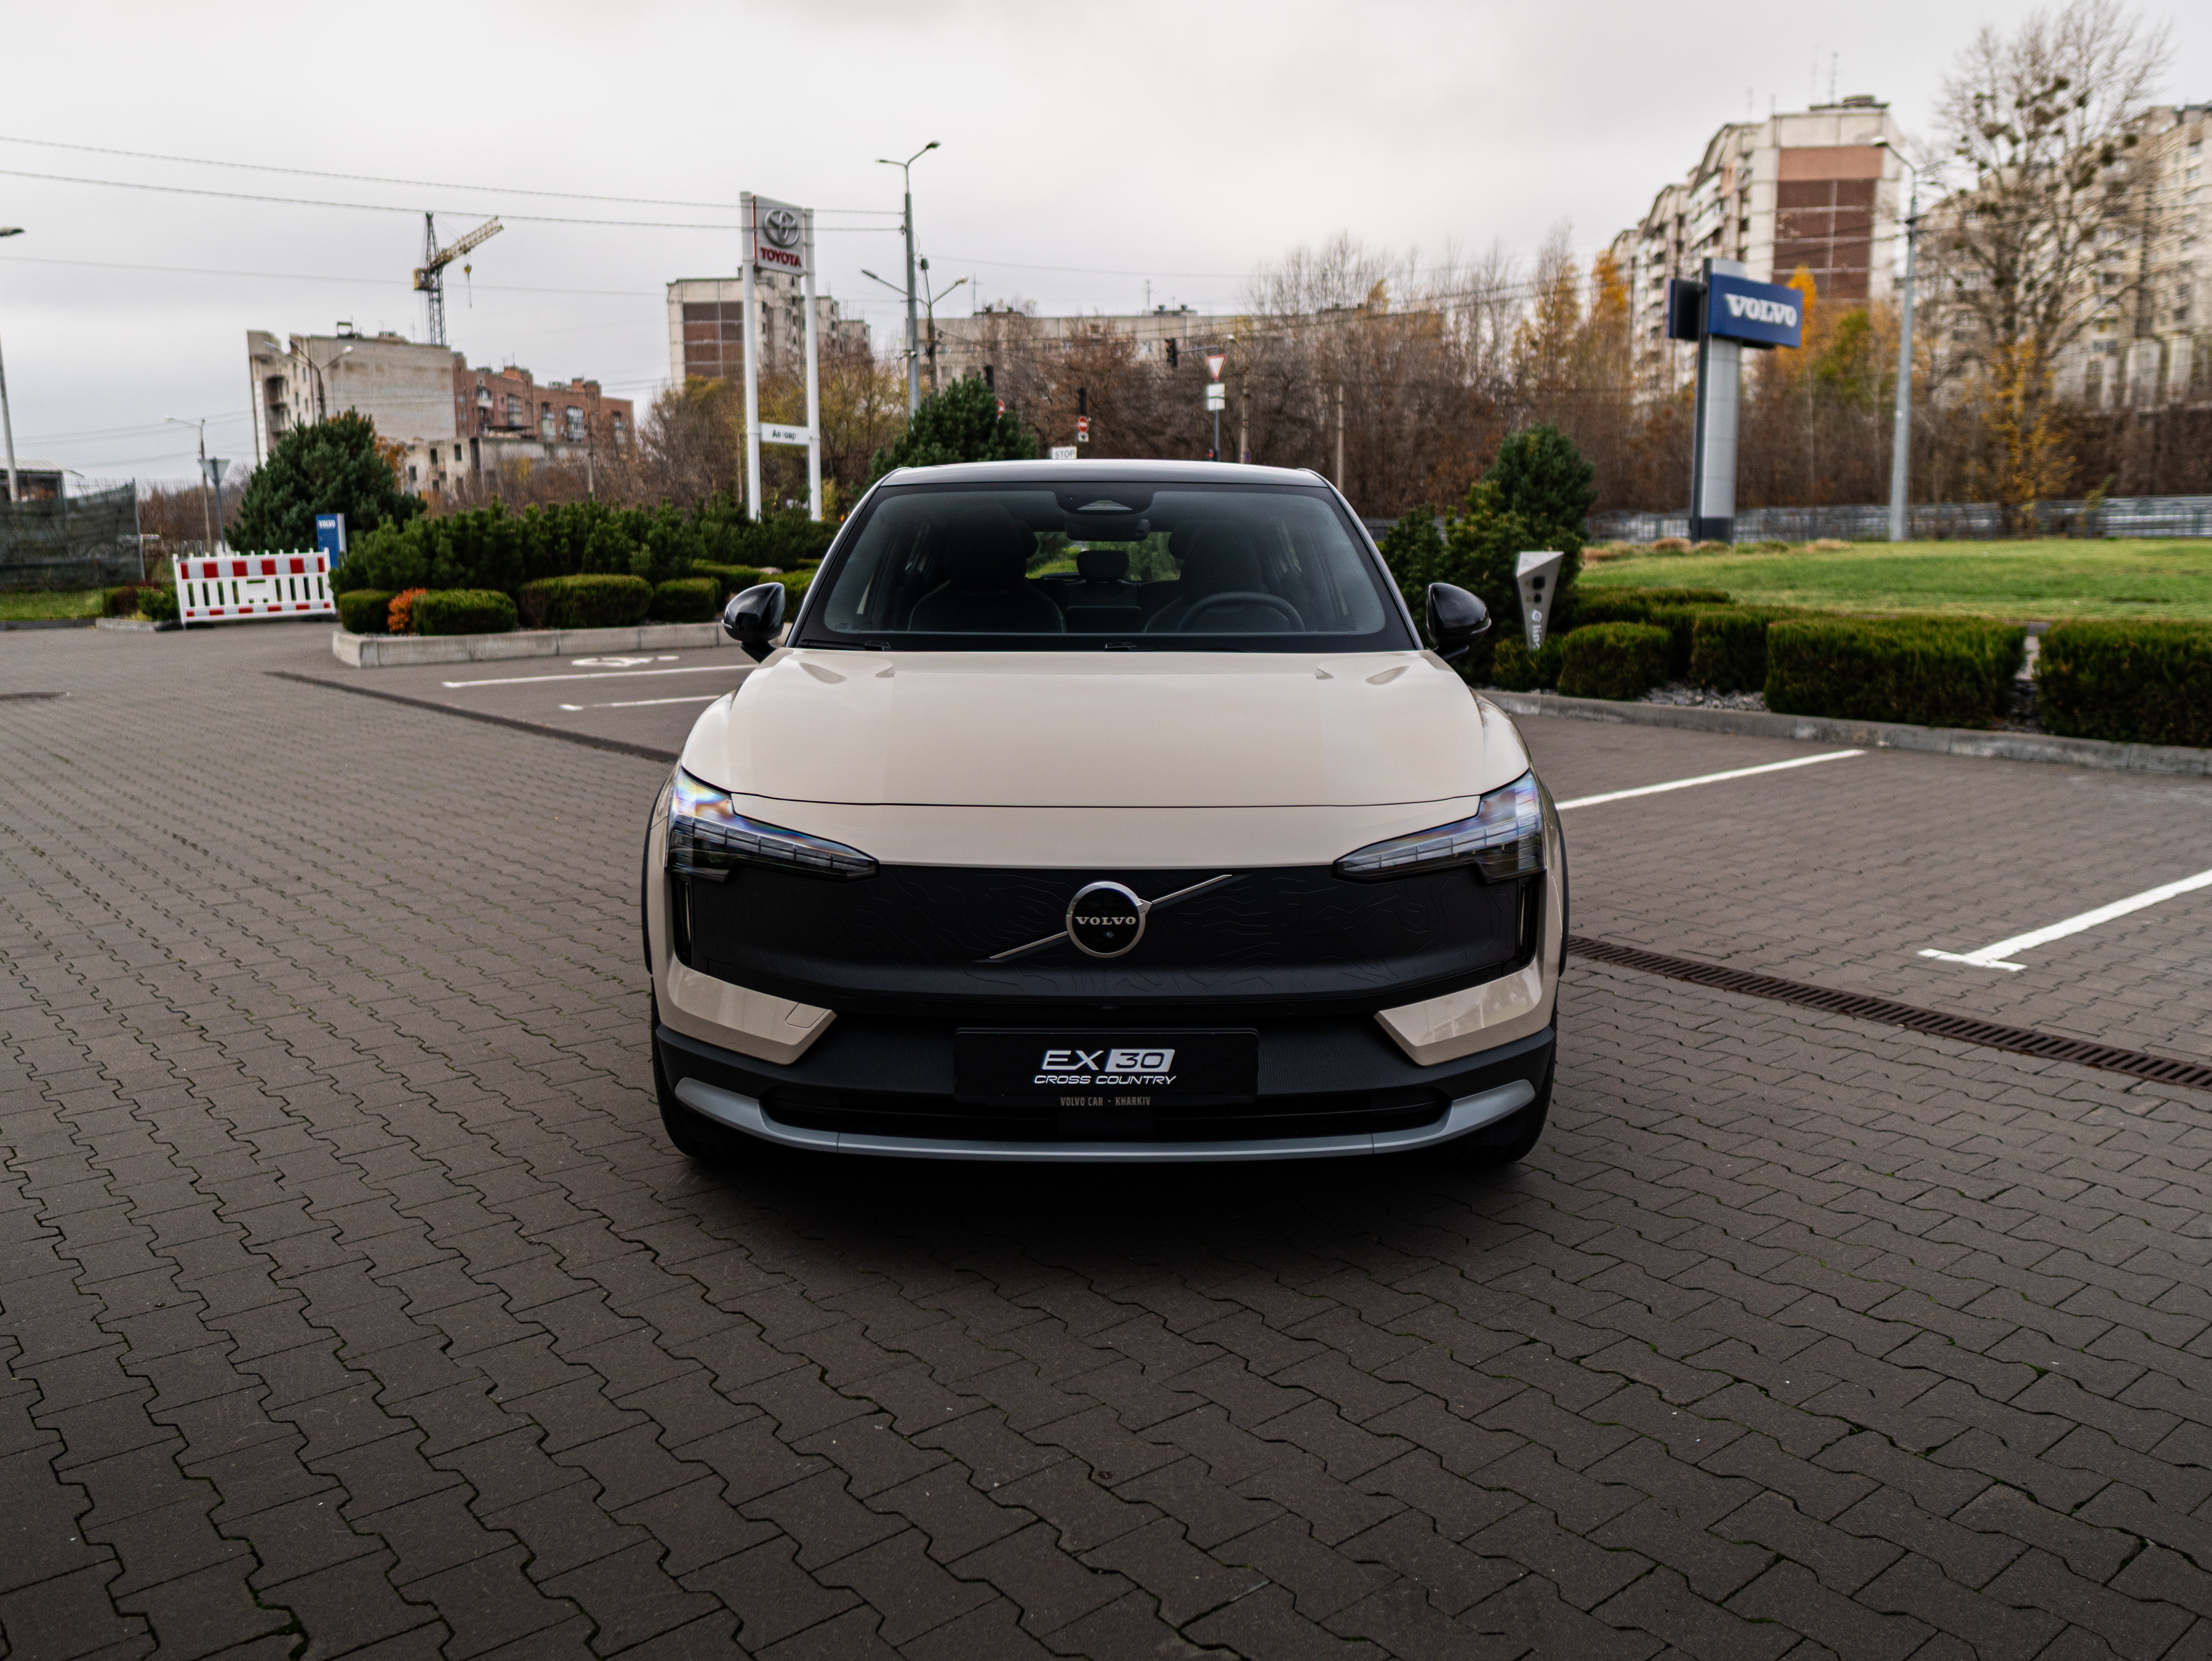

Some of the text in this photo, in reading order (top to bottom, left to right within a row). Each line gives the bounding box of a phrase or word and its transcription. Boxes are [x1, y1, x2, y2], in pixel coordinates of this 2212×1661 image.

[760, 246, 802, 267] TOYOTA
[1724, 293, 1797, 328] VOLVO
[1055, 449, 1075, 459] STOP
[318, 519, 336, 529] VOLVO
[1075, 916, 1136, 925] VOLVO
[1042, 1050, 1166, 1070] EX 30
[1034, 1075, 1177, 1085] CROSS COUNTRY
[1061, 1096, 1085, 1106] VOLVO
[1088, 1096, 1103, 1106] CAR
[1115, 1096, 1151, 1106] KHARKIV
